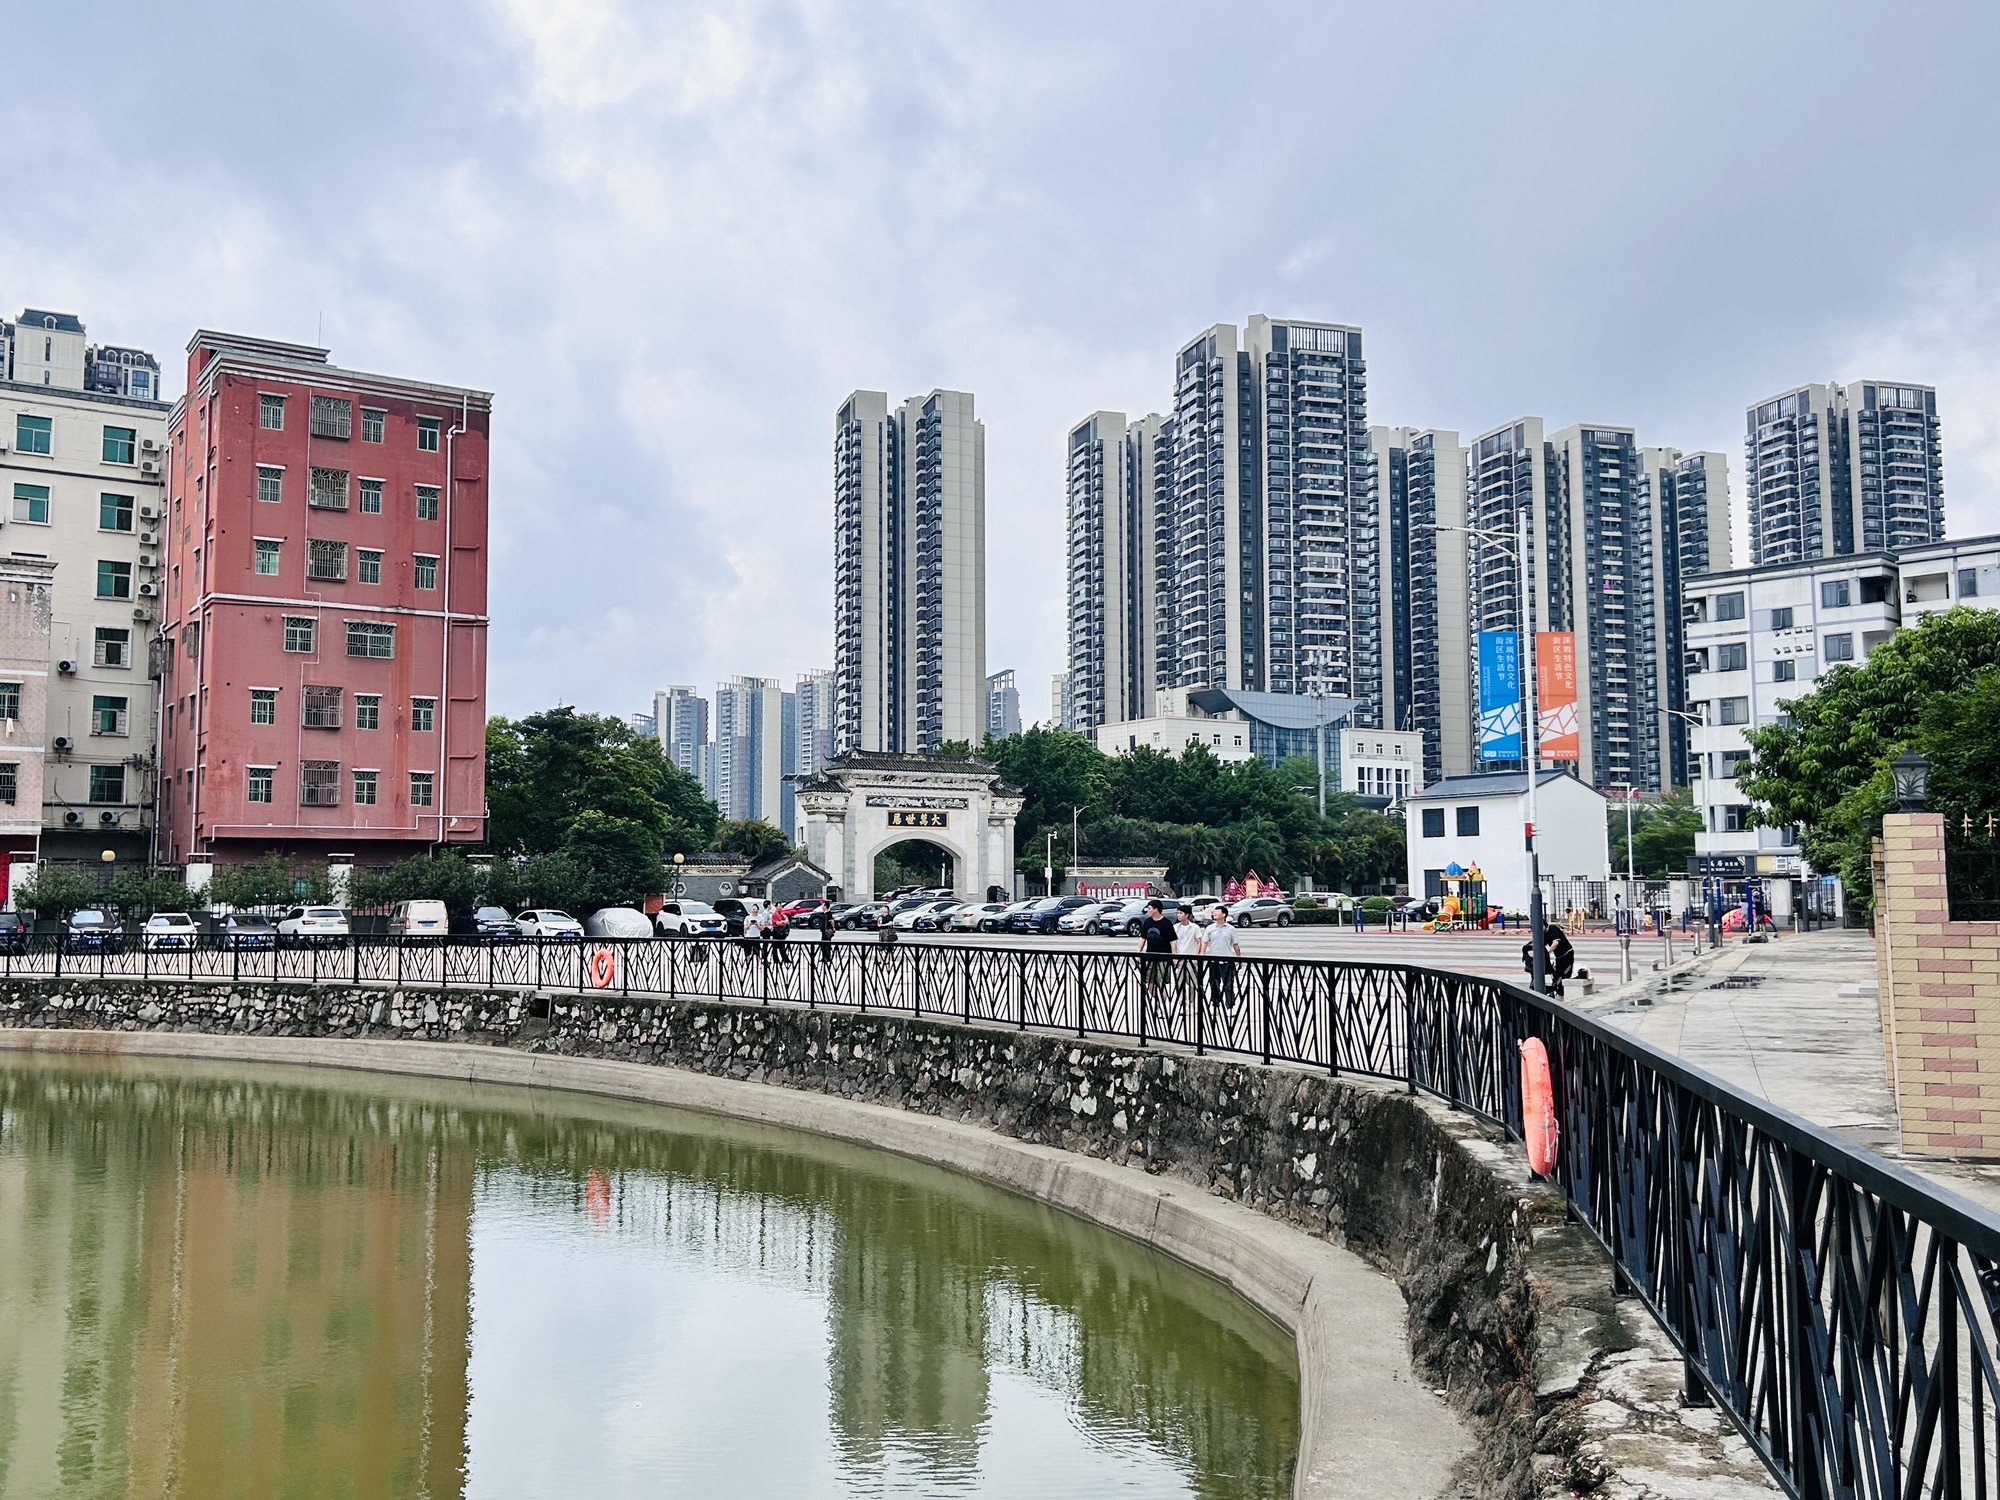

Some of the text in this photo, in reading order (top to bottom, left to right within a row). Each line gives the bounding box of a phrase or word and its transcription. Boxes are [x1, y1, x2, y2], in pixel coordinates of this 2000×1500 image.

[1495, 636, 1505, 680] 街区生活节
[1505, 636, 1516, 689] 深圳特色文化
[1553, 636, 1563, 680] 街区生活节
[1562, 636, 1573, 689] 深圳特色文化
[892, 812, 942, 826] 大萬世居
